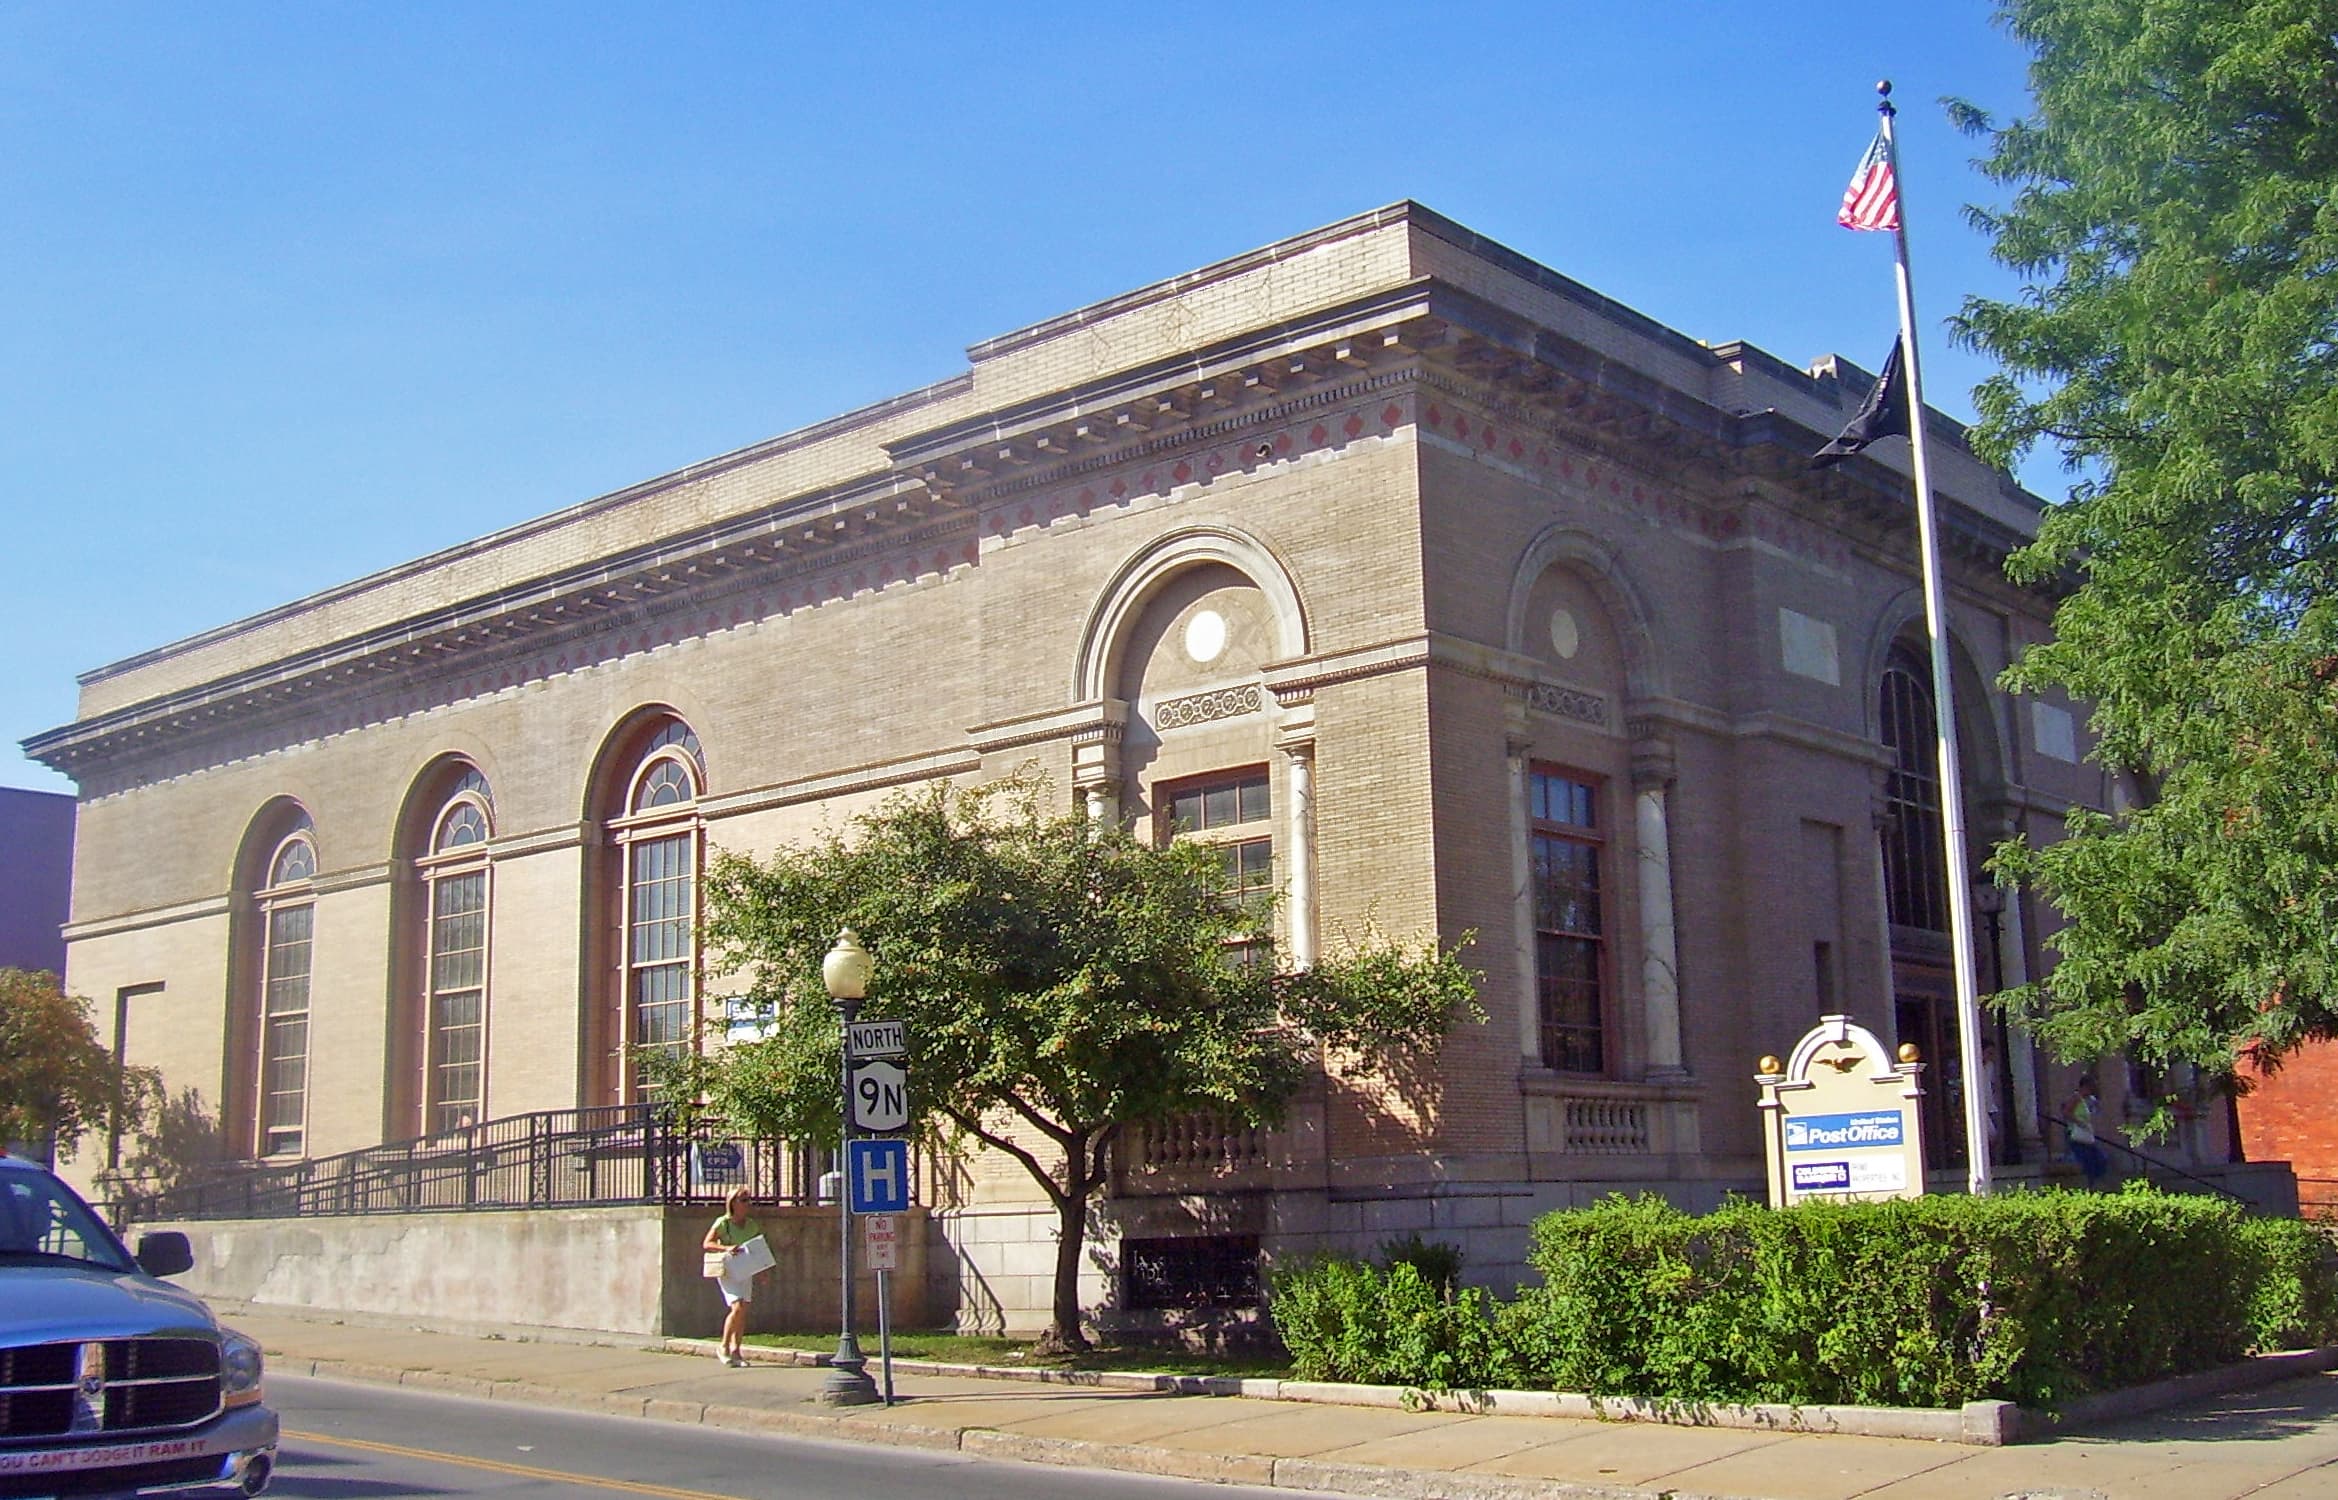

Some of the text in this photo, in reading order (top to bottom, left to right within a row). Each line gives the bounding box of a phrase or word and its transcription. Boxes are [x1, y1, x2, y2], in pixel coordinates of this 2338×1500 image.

[853, 1026, 903, 1050] NORTH
[859, 1077, 902, 1115] 9N
[862, 1151, 896, 1202] H
[870, 1231, 896, 1241] PARKING
[875, 1220, 887, 1230] NO
[0, 1455, 23, 1469] OU
[150, 1442, 187, 1456] RAM
[192, 1439, 207, 1452] IT
